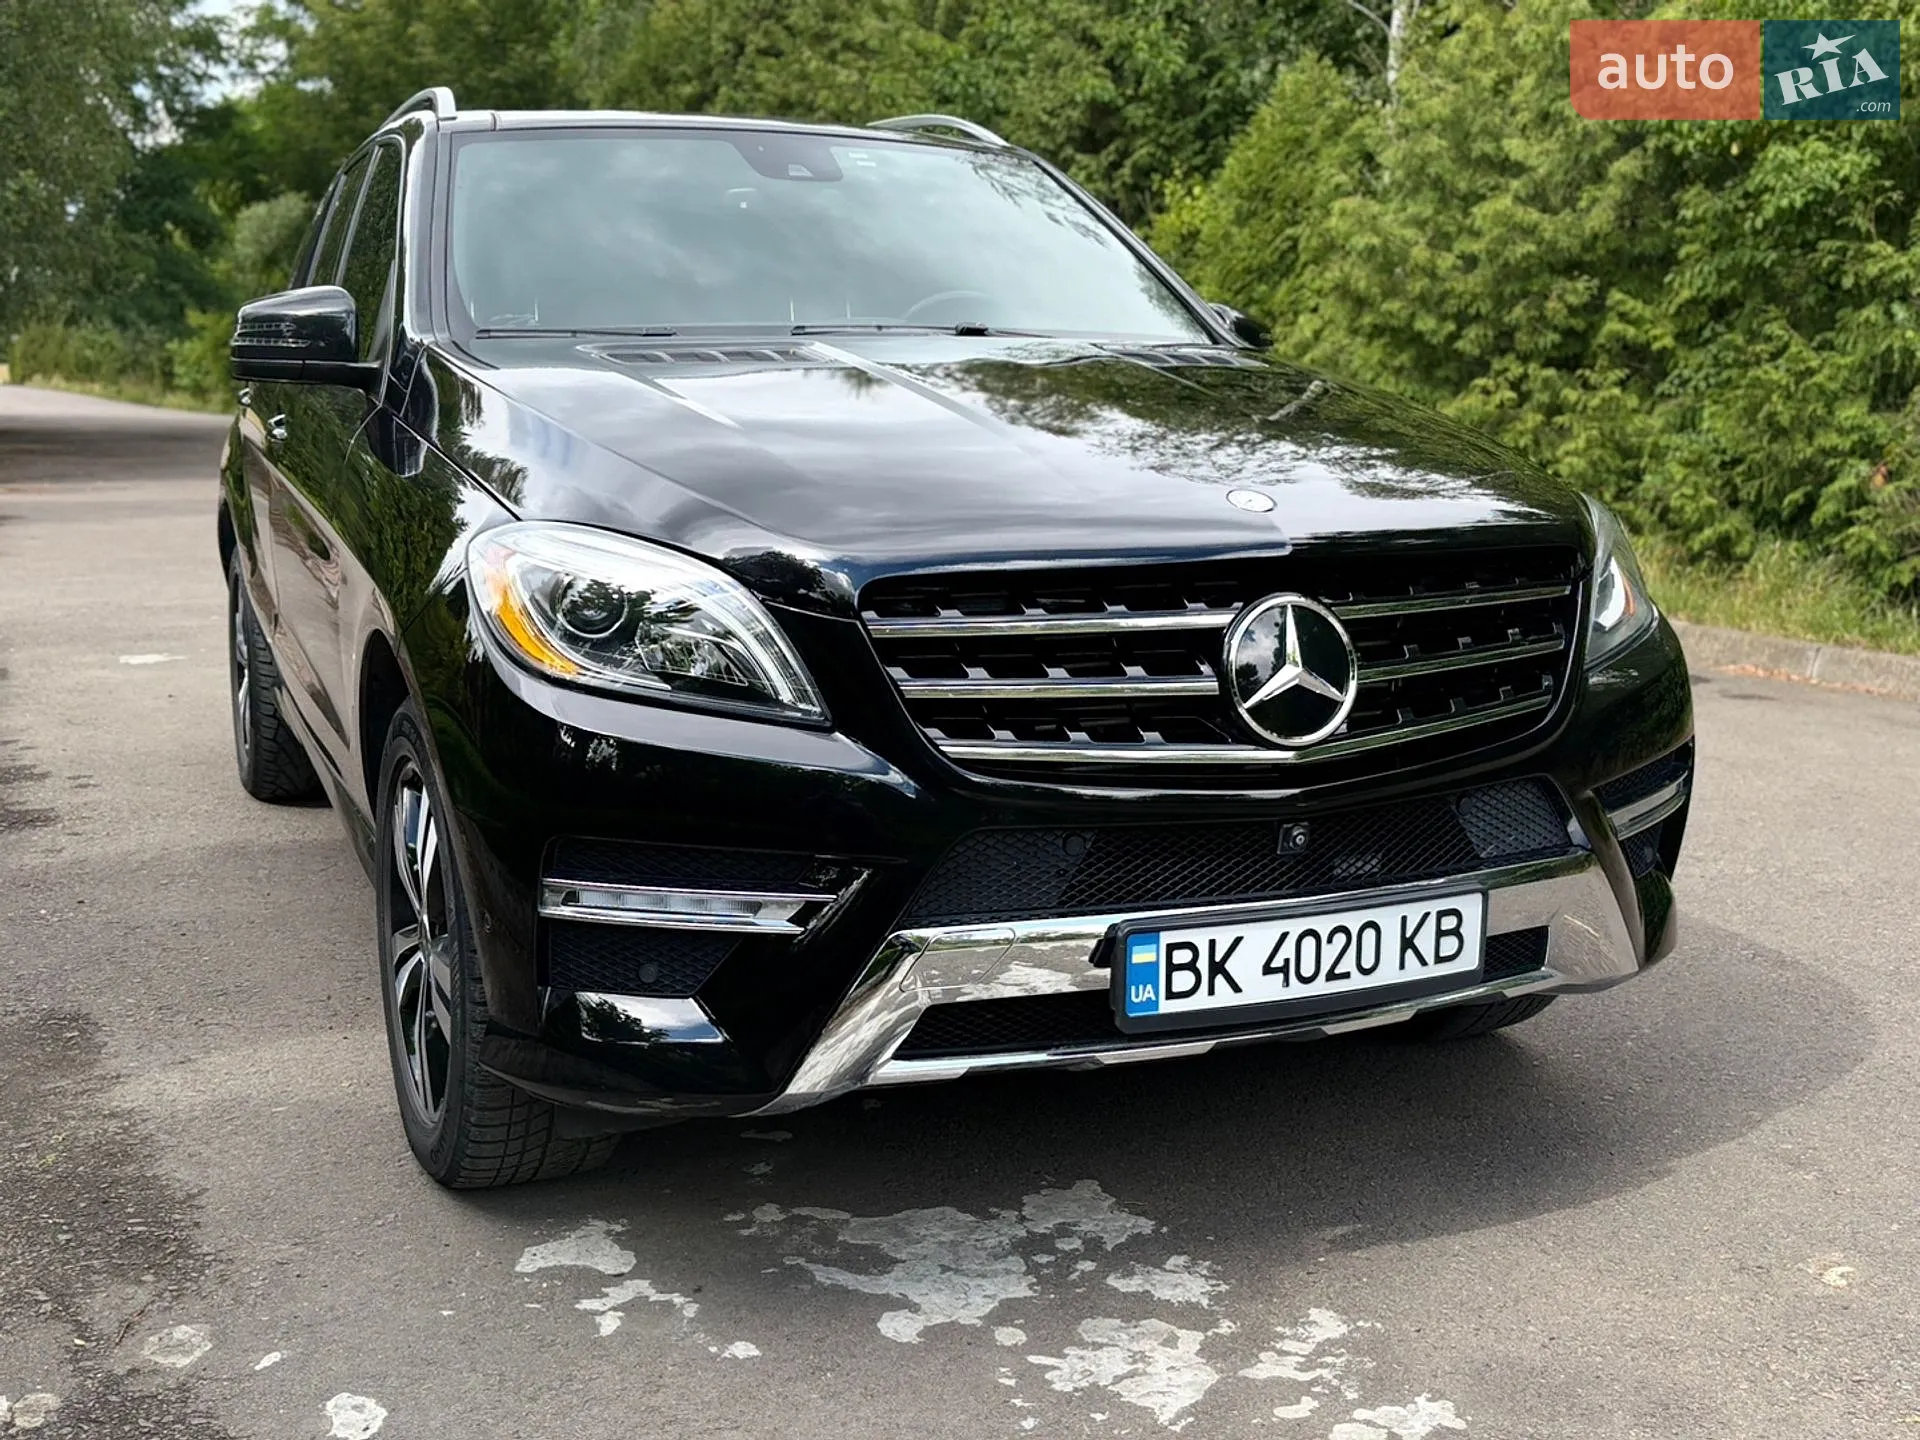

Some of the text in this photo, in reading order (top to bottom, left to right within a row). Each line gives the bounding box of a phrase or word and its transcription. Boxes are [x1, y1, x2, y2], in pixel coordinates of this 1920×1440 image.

[1164, 907, 1465, 1001] BK 4020 KB
[1130, 985, 1156, 1003] UA
